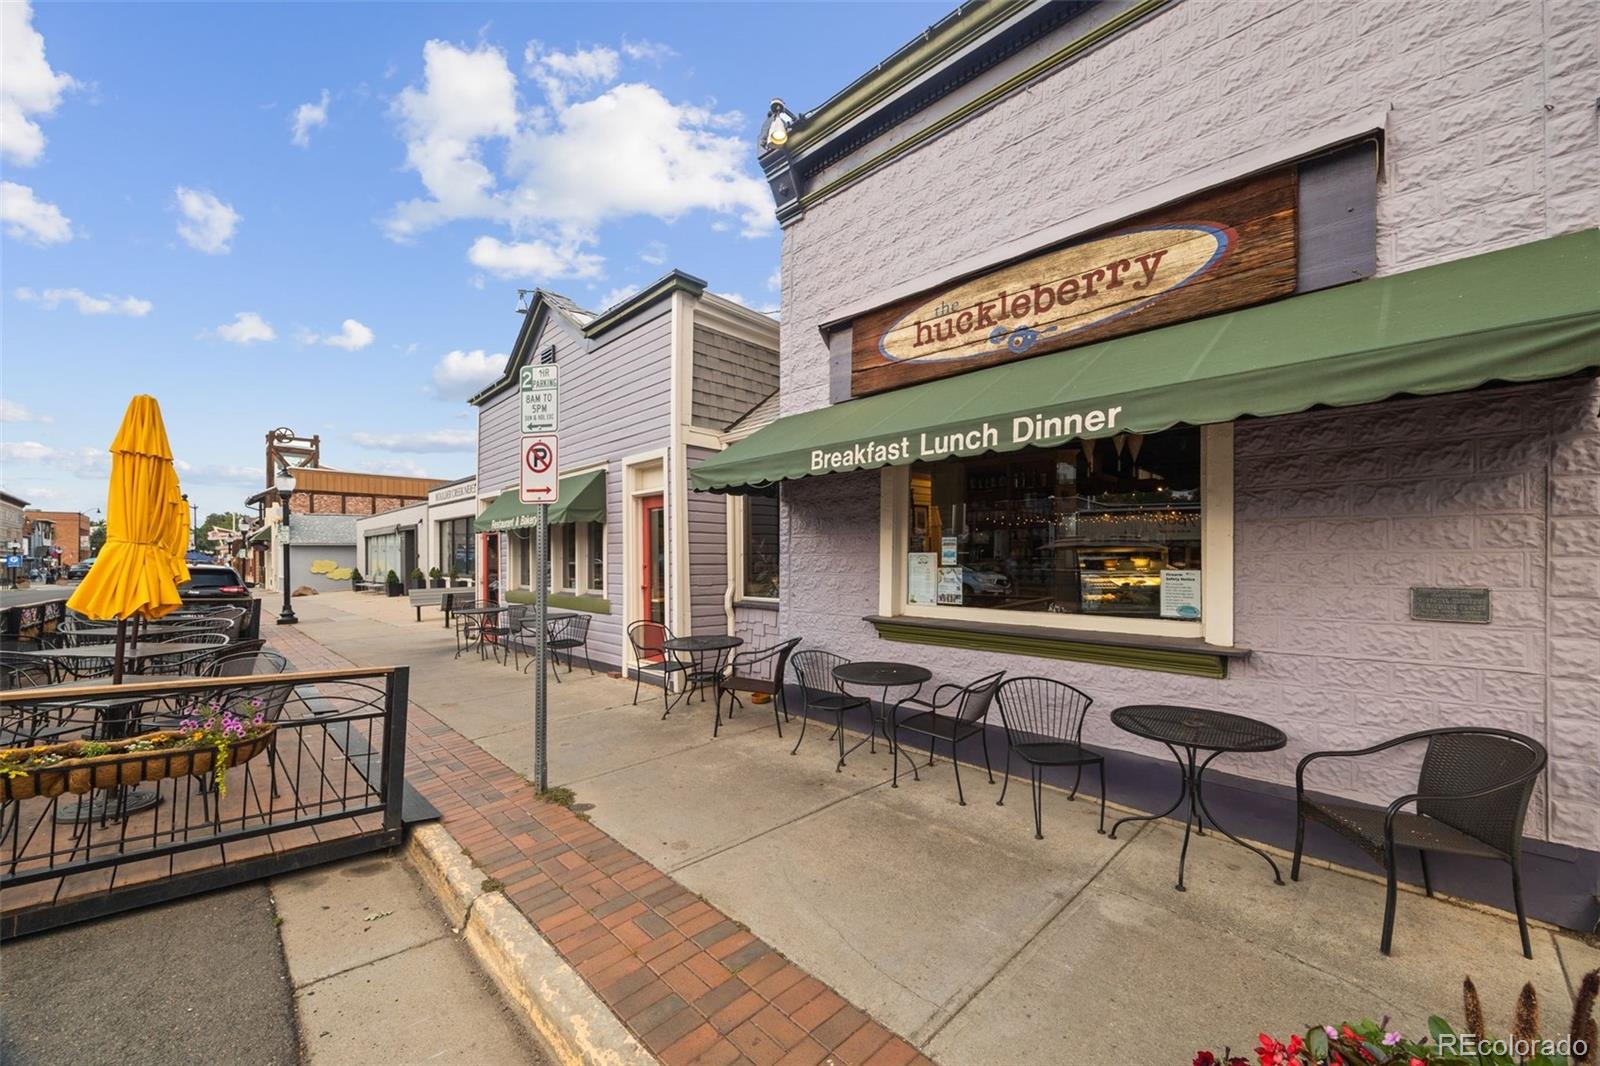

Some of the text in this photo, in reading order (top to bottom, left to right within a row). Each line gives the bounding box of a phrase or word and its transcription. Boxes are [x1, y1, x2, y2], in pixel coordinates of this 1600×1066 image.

[912, 249, 1169, 348] huckleberry
[933, 298, 960, 318] the
[522, 371, 532, 389] 2
[532, 378, 557, 388] PARKING
[526, 393, 553, 404] 8AM TO
[532, 404, 547, 413] 5PM
[810, 405, 1123, 471] Breakfast Lunch Dinner
